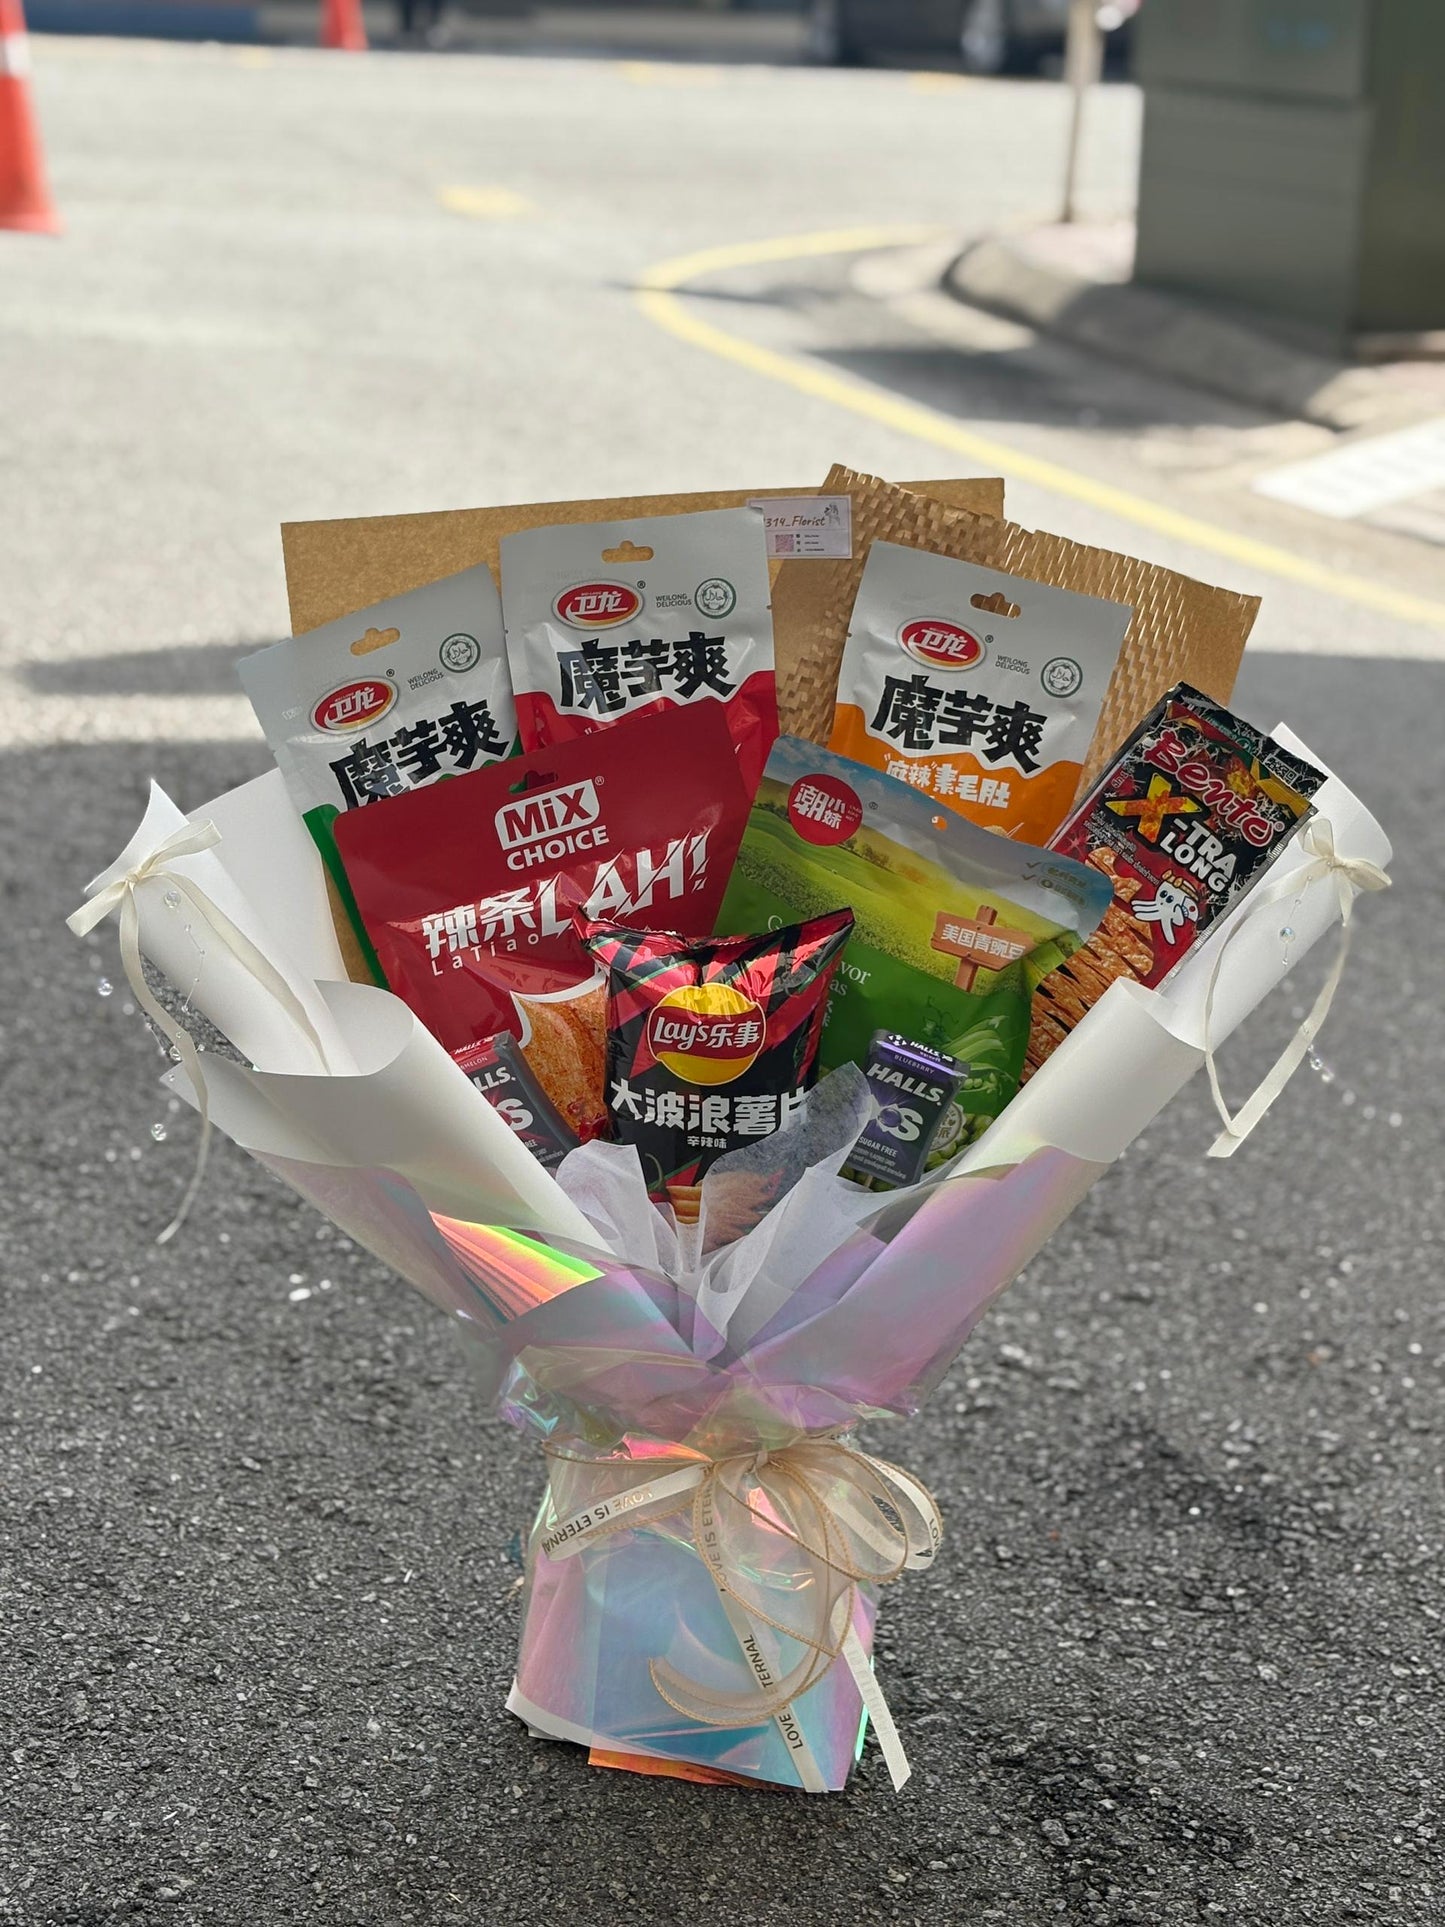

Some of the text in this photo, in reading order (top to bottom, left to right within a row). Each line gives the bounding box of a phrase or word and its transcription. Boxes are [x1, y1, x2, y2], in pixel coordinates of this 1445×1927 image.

[764, 515, 825, 528] 314_Florist
[572, 591, 628, 616] 卫龙
[655, 593, 688, 602] WEILONG
[656, 599, 692, 608] DELICIOUS
[912, 628, 969, 661] 卫龙
[557, 632, 737, 714] 魔芋爽
[995, 660, 1031, 676] DELICIOUS
[997, 654, 1029, 669] WEILONG
[407, 668, 439, 686] WEILONG
[409, 672, 445, 692] DELICIOUS
[327, 686, 384, 723] 卫龙
[870, 674, 1048, 774] 魔芋爽
[329, 699, 510, 811] 魔芋爽
[1143, 729, 1274, 847] Bento
[506, 825, 611, 871] CHOICE
[1160, 831, 1231, 893] LONG
[836, 960, 871, 985] vor
[911, 1041, 939, 1056] HALLS
[894, 1054, 935, 1074] BLUEBERRY
[610, 1078, 811, 1136] 大波浪薯片
[686, 1136, 727, 1150] 辛辣味
[858, 1136, 881, 1152] SUGAR
[880, 1144, 898, 1158] FREE
[594, 1504, 610, 1520] IS
[541, 1515, 592, 1553] ETERNA
[704, 1532, 717, 1548] IS
[778, 1713, 804, 1750] LOVE
